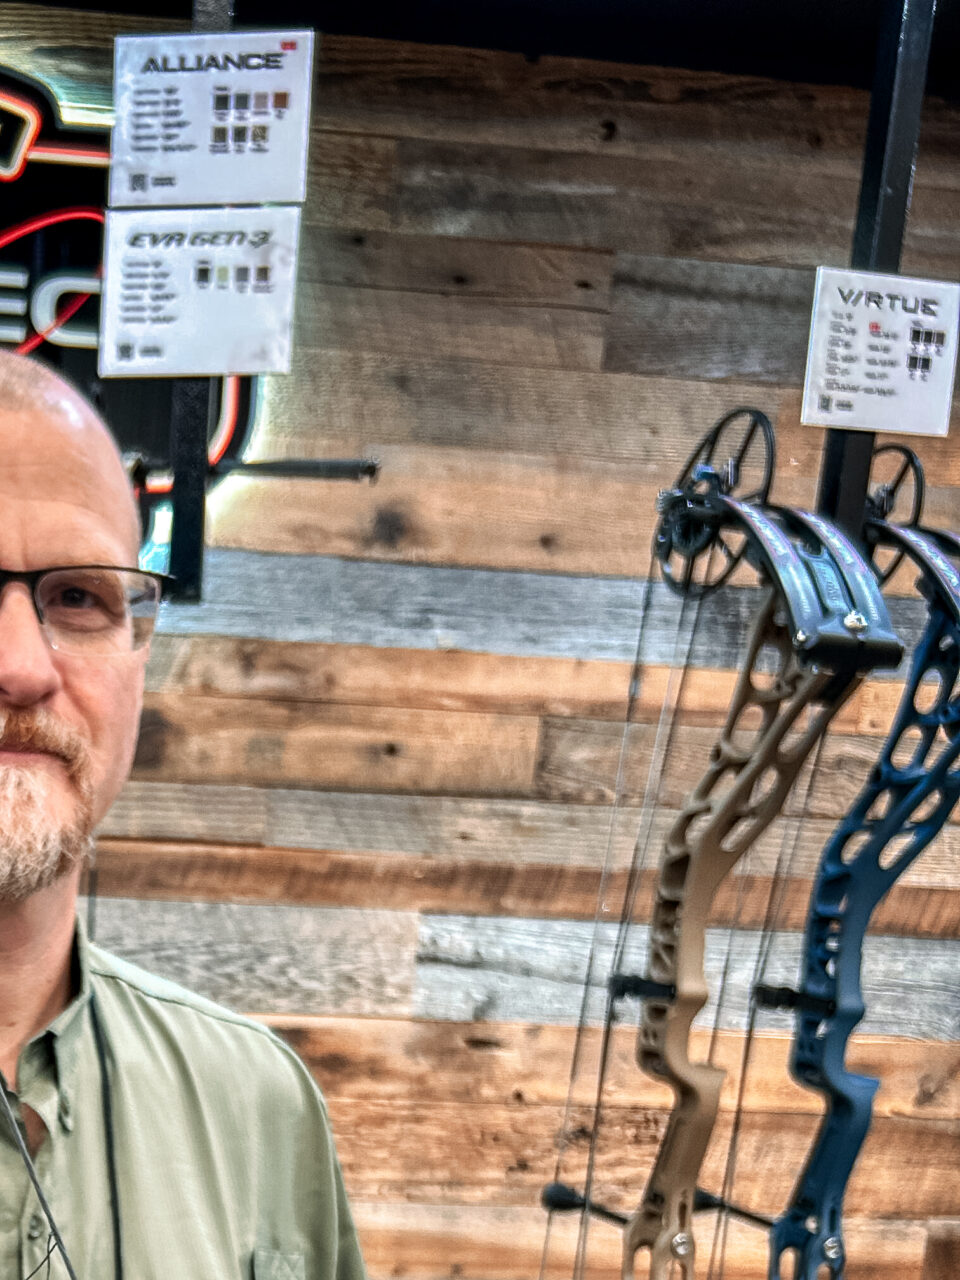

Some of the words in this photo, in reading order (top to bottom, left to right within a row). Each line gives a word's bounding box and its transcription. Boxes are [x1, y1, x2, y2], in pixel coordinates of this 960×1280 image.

[141, 52, 284, 74] ALLIANCE
[127, 231, 185, 248] EVA
[188, 230, 246, 247] GEN
[248, 230, 273, 249] 3
